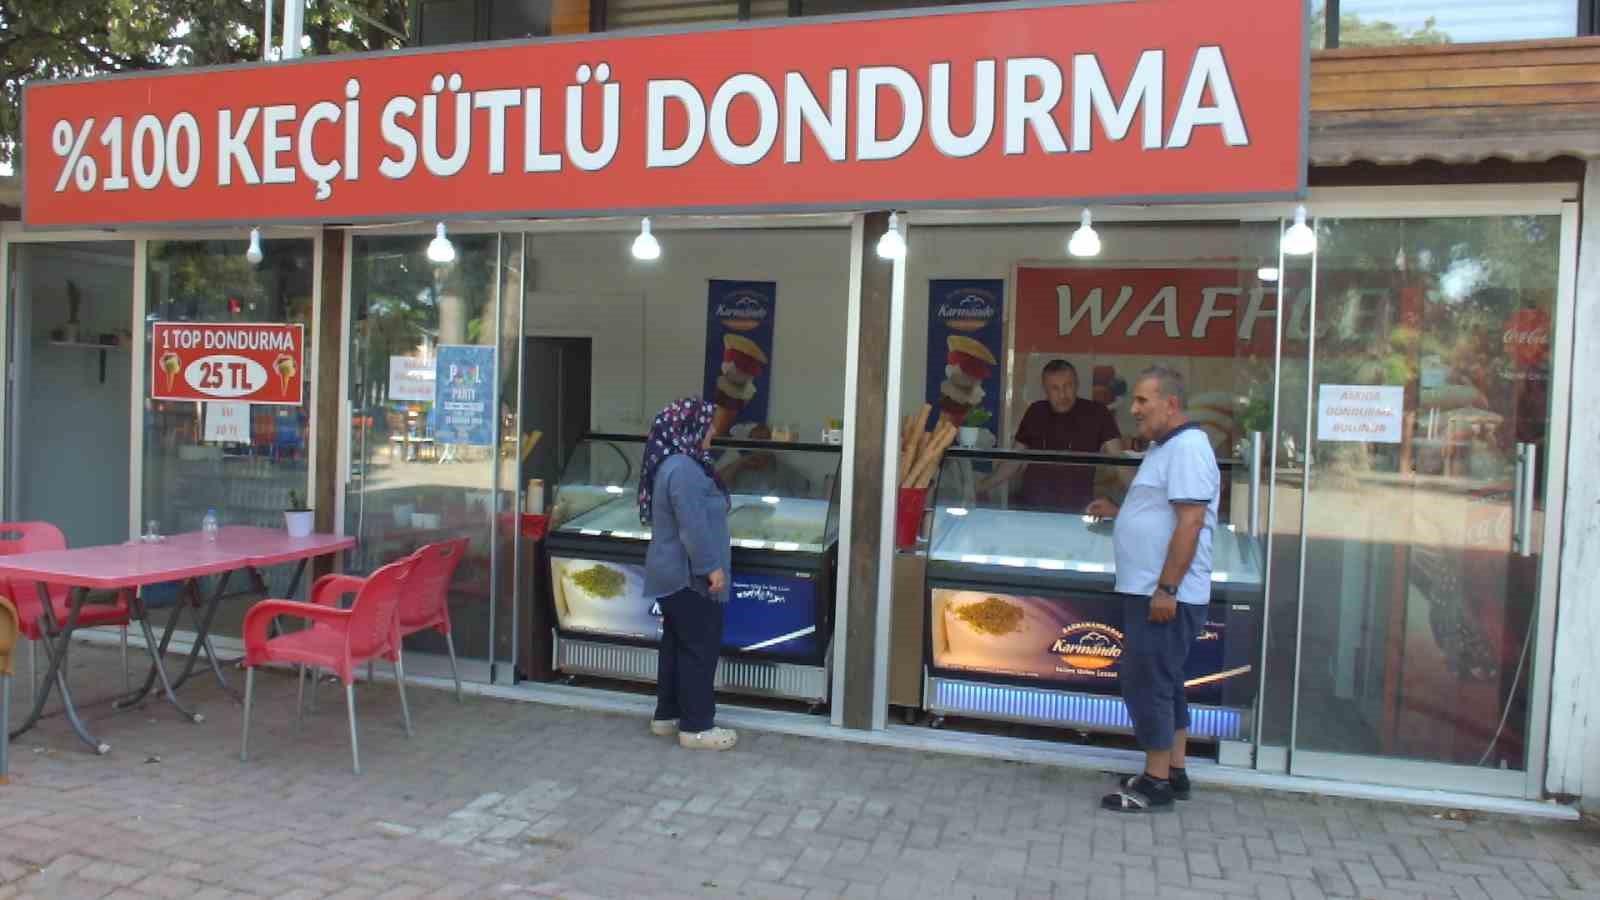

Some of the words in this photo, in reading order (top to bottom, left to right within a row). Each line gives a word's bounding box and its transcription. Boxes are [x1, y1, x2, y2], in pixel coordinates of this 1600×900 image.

[51, 111, 201, 193] %100
[217, 78, 361, 200] KEÇİ
[377, 62, 621, 179] SÜTLÜ
[645, 44, 1250, 169] DONDURMA
[162, 329, 169, 349] 1
[171, 330, 201, 349] TOP
[204, 330, 295, 350] DONDURMA
[199, 361, 223, 389] 25
[227, 362, 253, 390] TL
